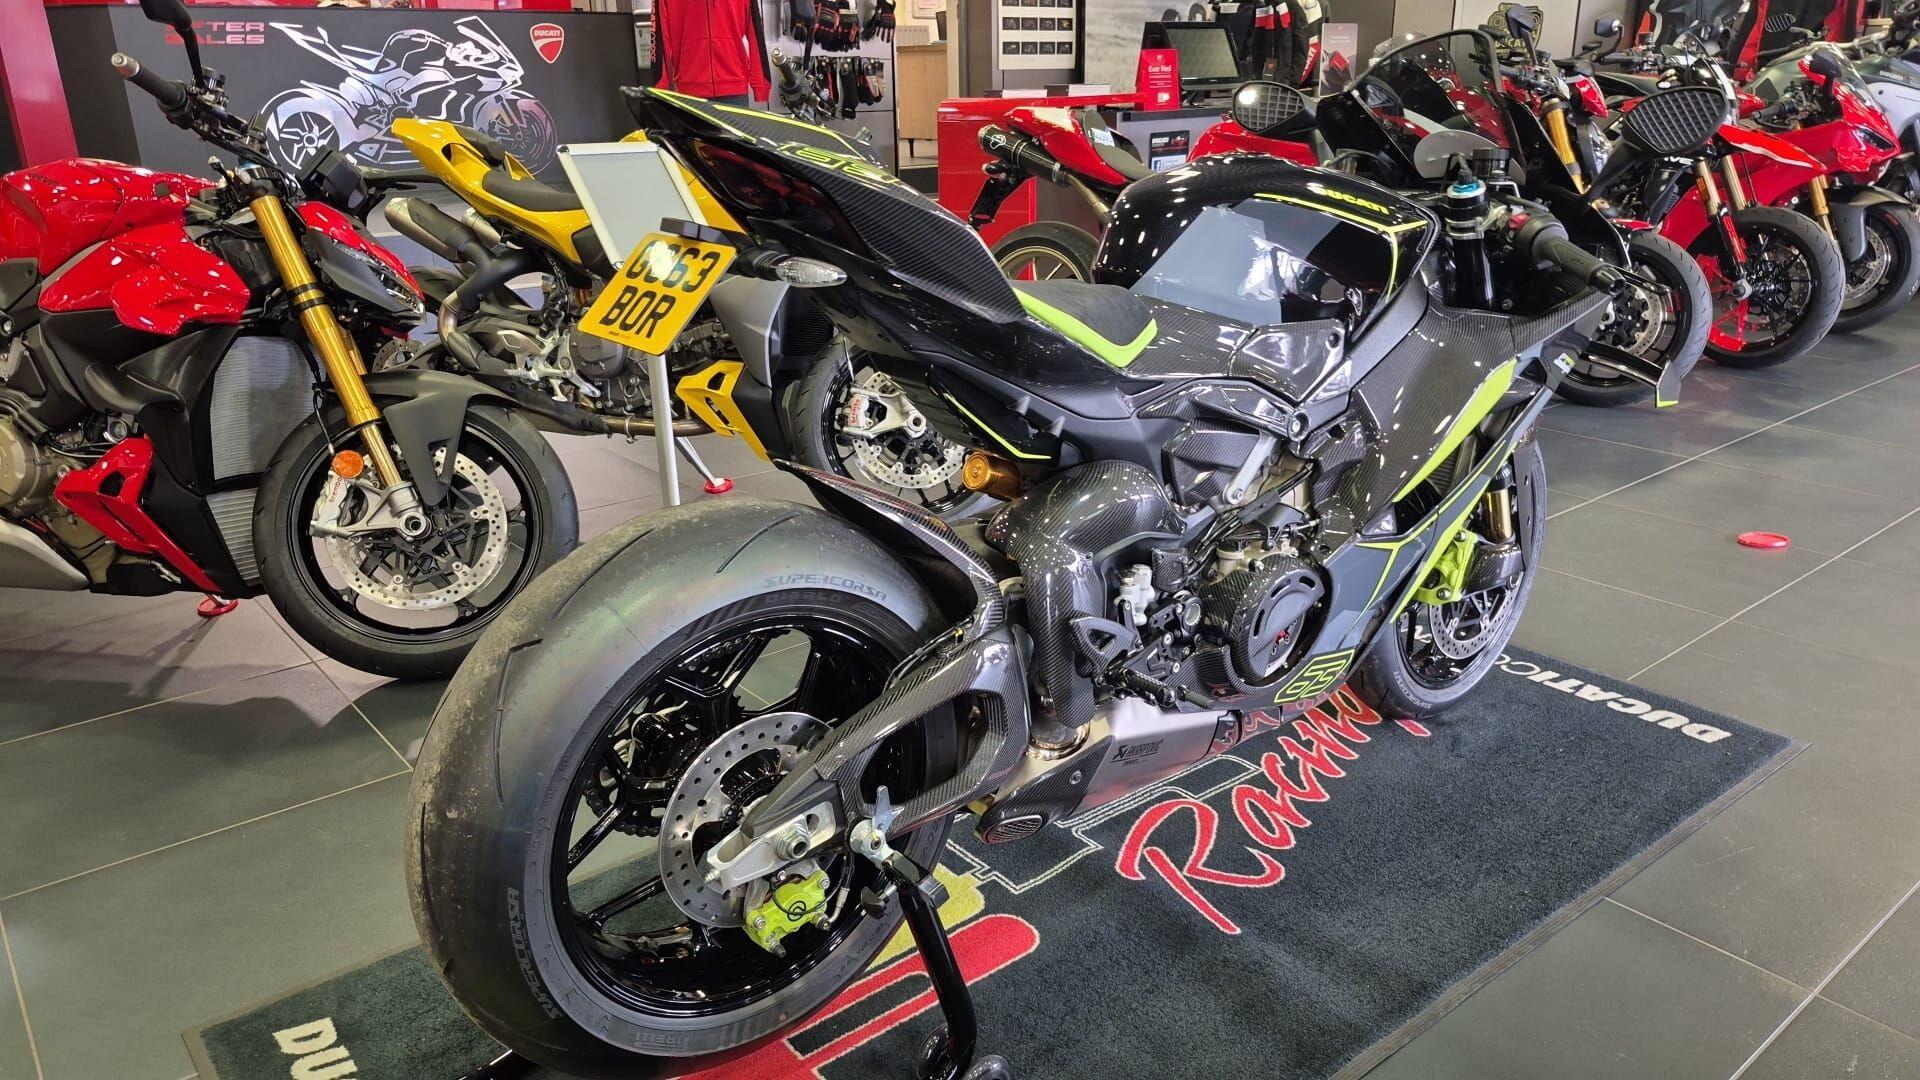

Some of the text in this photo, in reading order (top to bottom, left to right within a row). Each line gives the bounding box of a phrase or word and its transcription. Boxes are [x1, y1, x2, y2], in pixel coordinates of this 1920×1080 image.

[533, 29, 561, 37] DUCATI
[599, 285, 677, 339] BOR
[329, 477, 342, 503] brembo
[763, 573, 888, 601] SUPERCORSA
[1526, 670, 1733, 743] DUCATI
[507, 887, 562, 1019] SUPERCORSA
